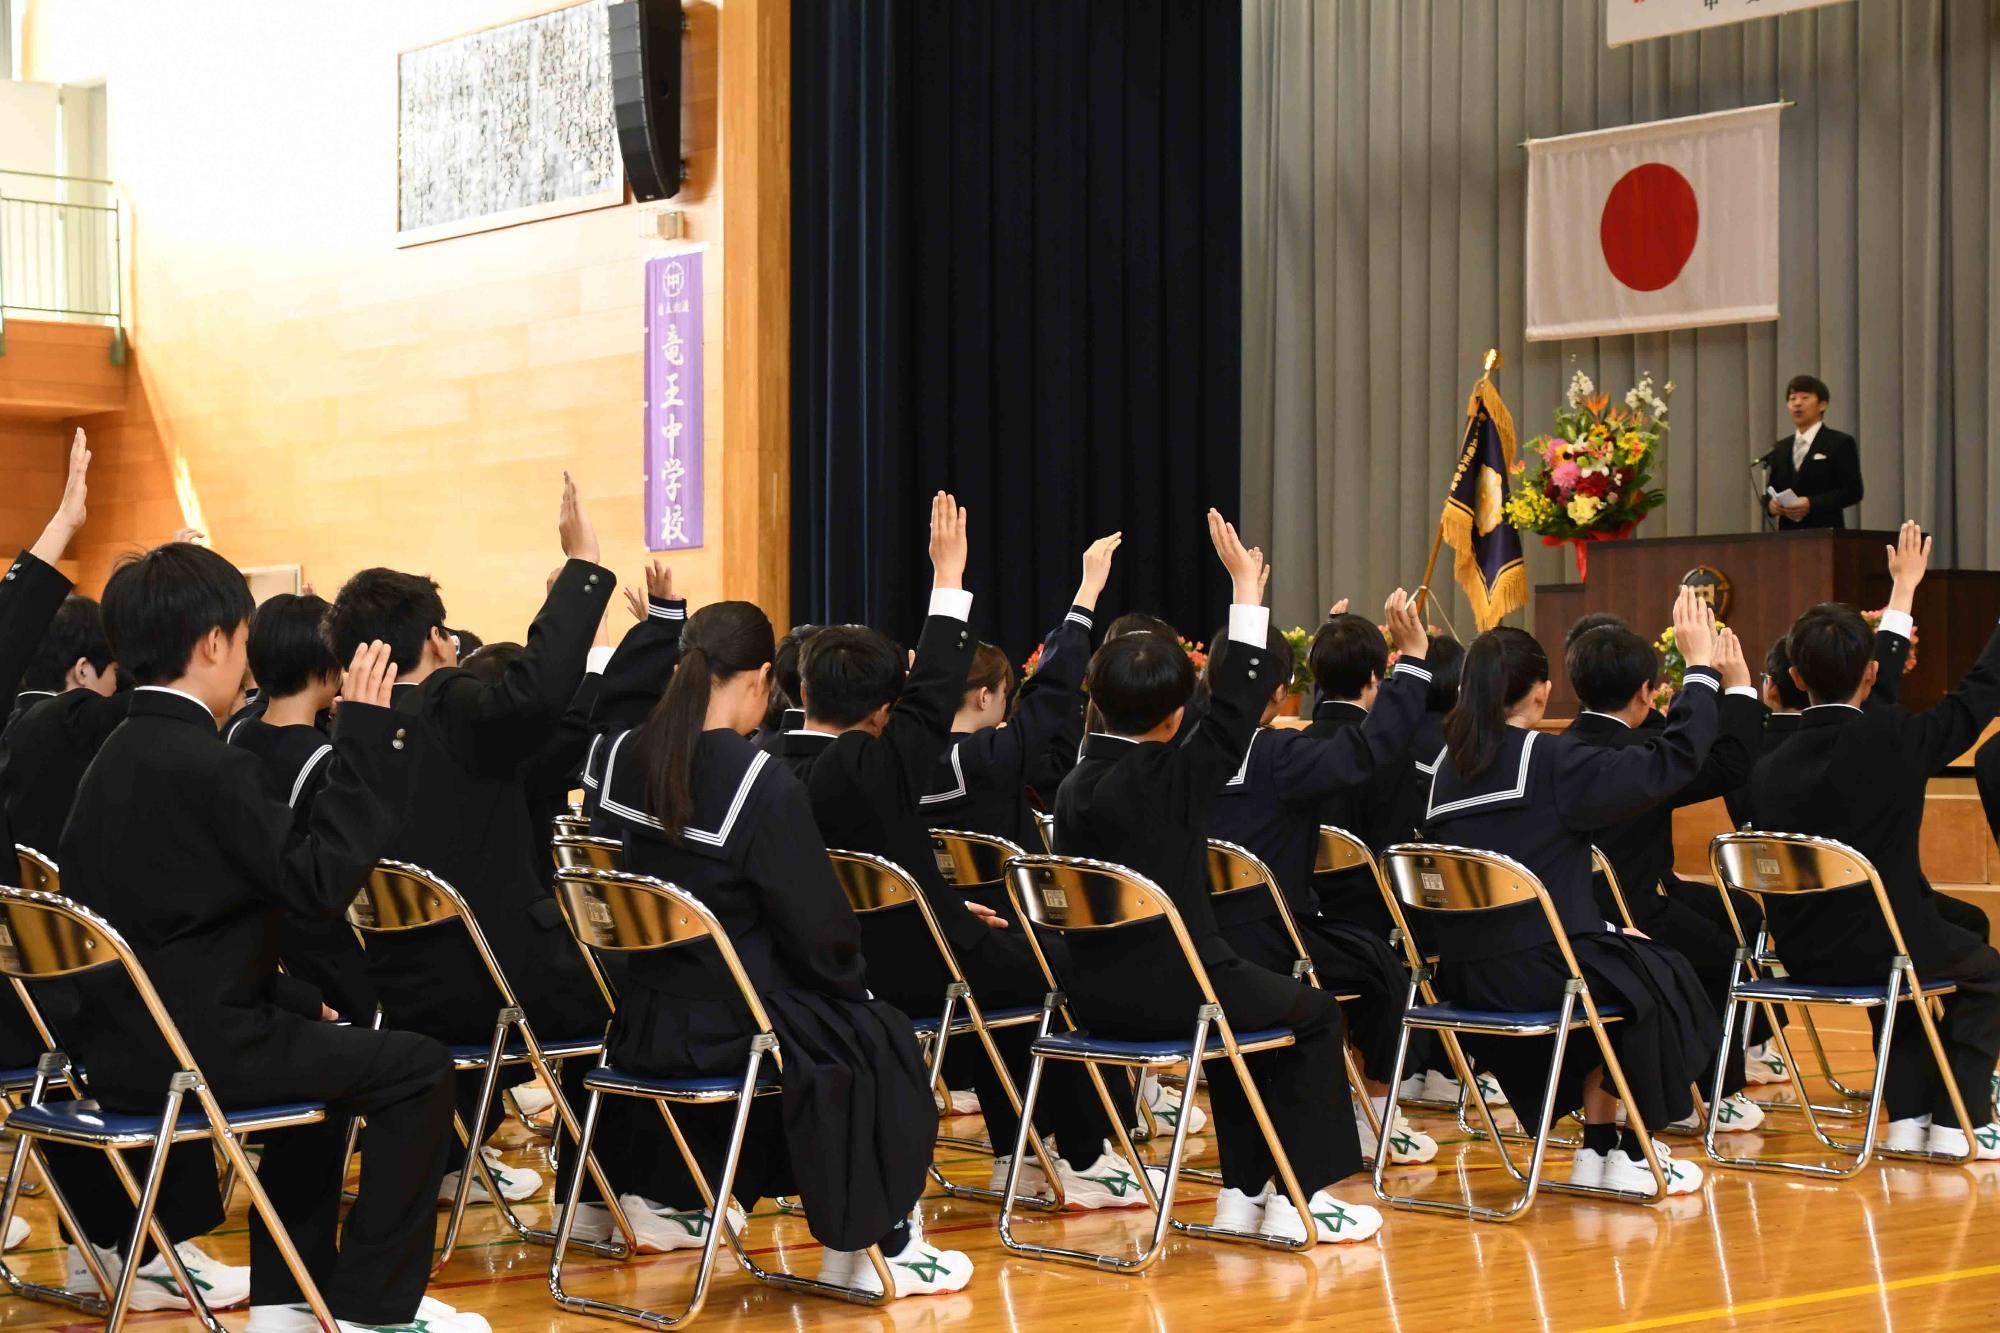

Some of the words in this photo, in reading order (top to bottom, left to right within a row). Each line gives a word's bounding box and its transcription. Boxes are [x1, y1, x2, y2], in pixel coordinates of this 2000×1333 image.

[660, 323, 689, 546] 竜王中学校
